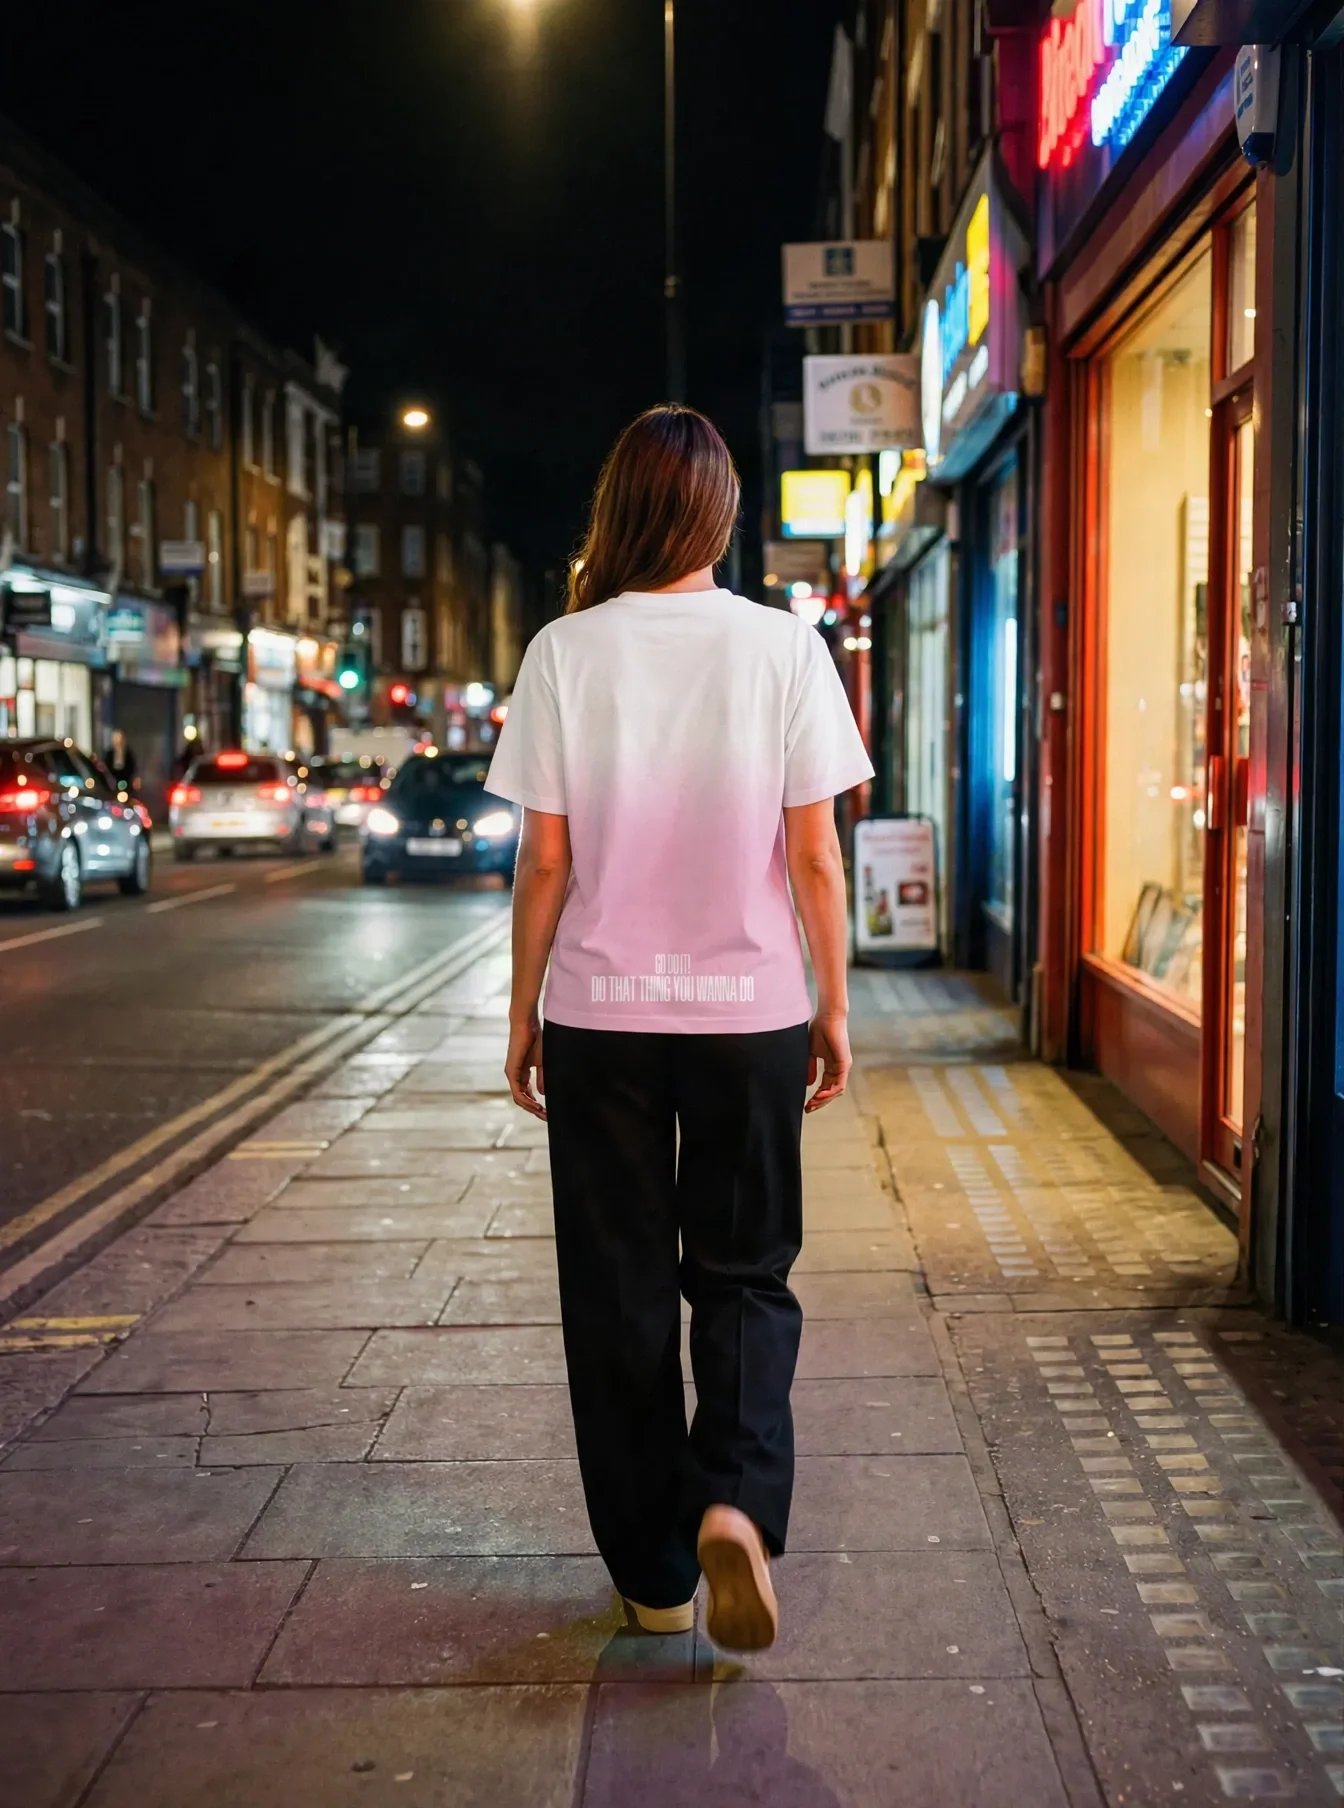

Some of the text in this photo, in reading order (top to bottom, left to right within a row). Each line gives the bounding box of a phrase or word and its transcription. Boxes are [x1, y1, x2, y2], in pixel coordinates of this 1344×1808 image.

[655, 953, 691, 974] GO DO IT!
[591, 976, 754, 1002] DO THAT THING YOU WANNA DO
